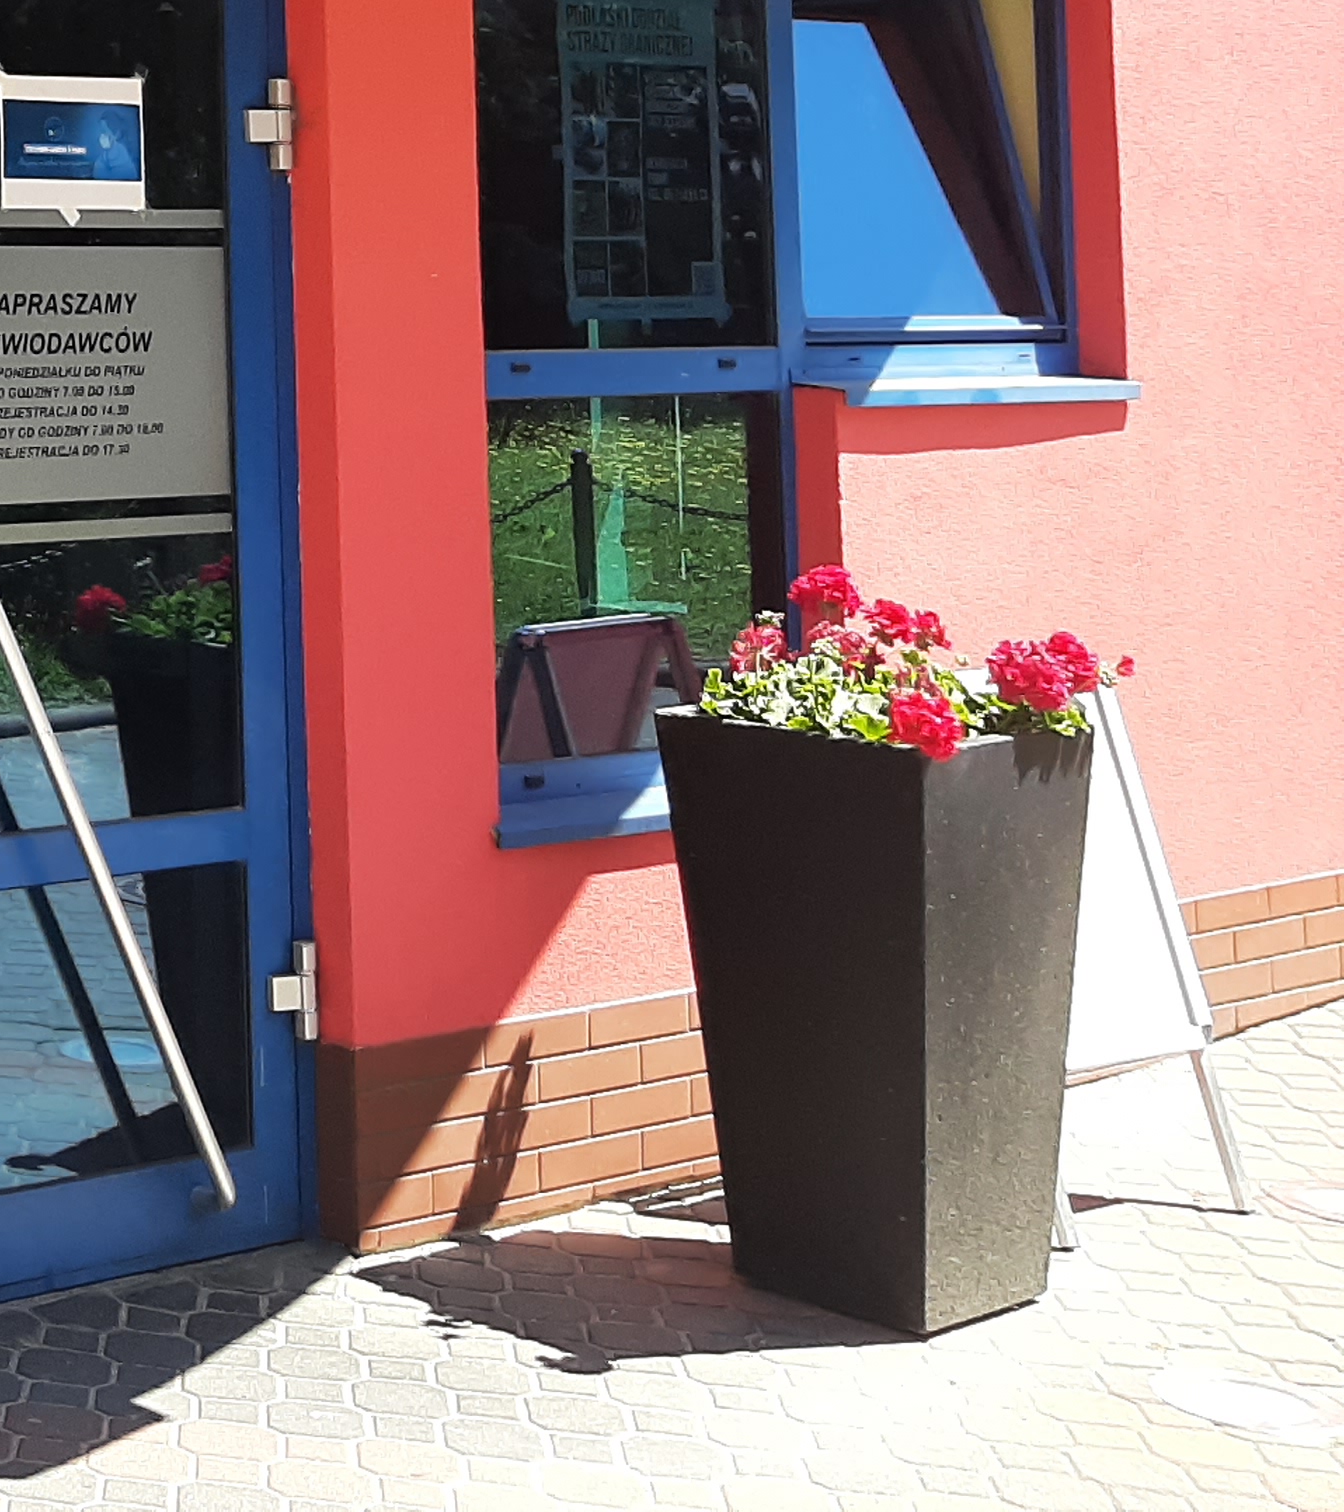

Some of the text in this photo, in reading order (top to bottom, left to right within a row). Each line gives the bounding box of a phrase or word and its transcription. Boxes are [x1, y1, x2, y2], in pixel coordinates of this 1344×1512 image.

[84, 365, 101, 377] DO
[8, 387, 59, 399] GODZINY
[87, 386, 104, 397] DO
[81, 405, 97, 416] DO
[18, 427, 35, 438] OD
[38, 426, 89, 437] GODZINY
[117, 424, 133, 435] DO
[83, 445, 99, 456] DO
